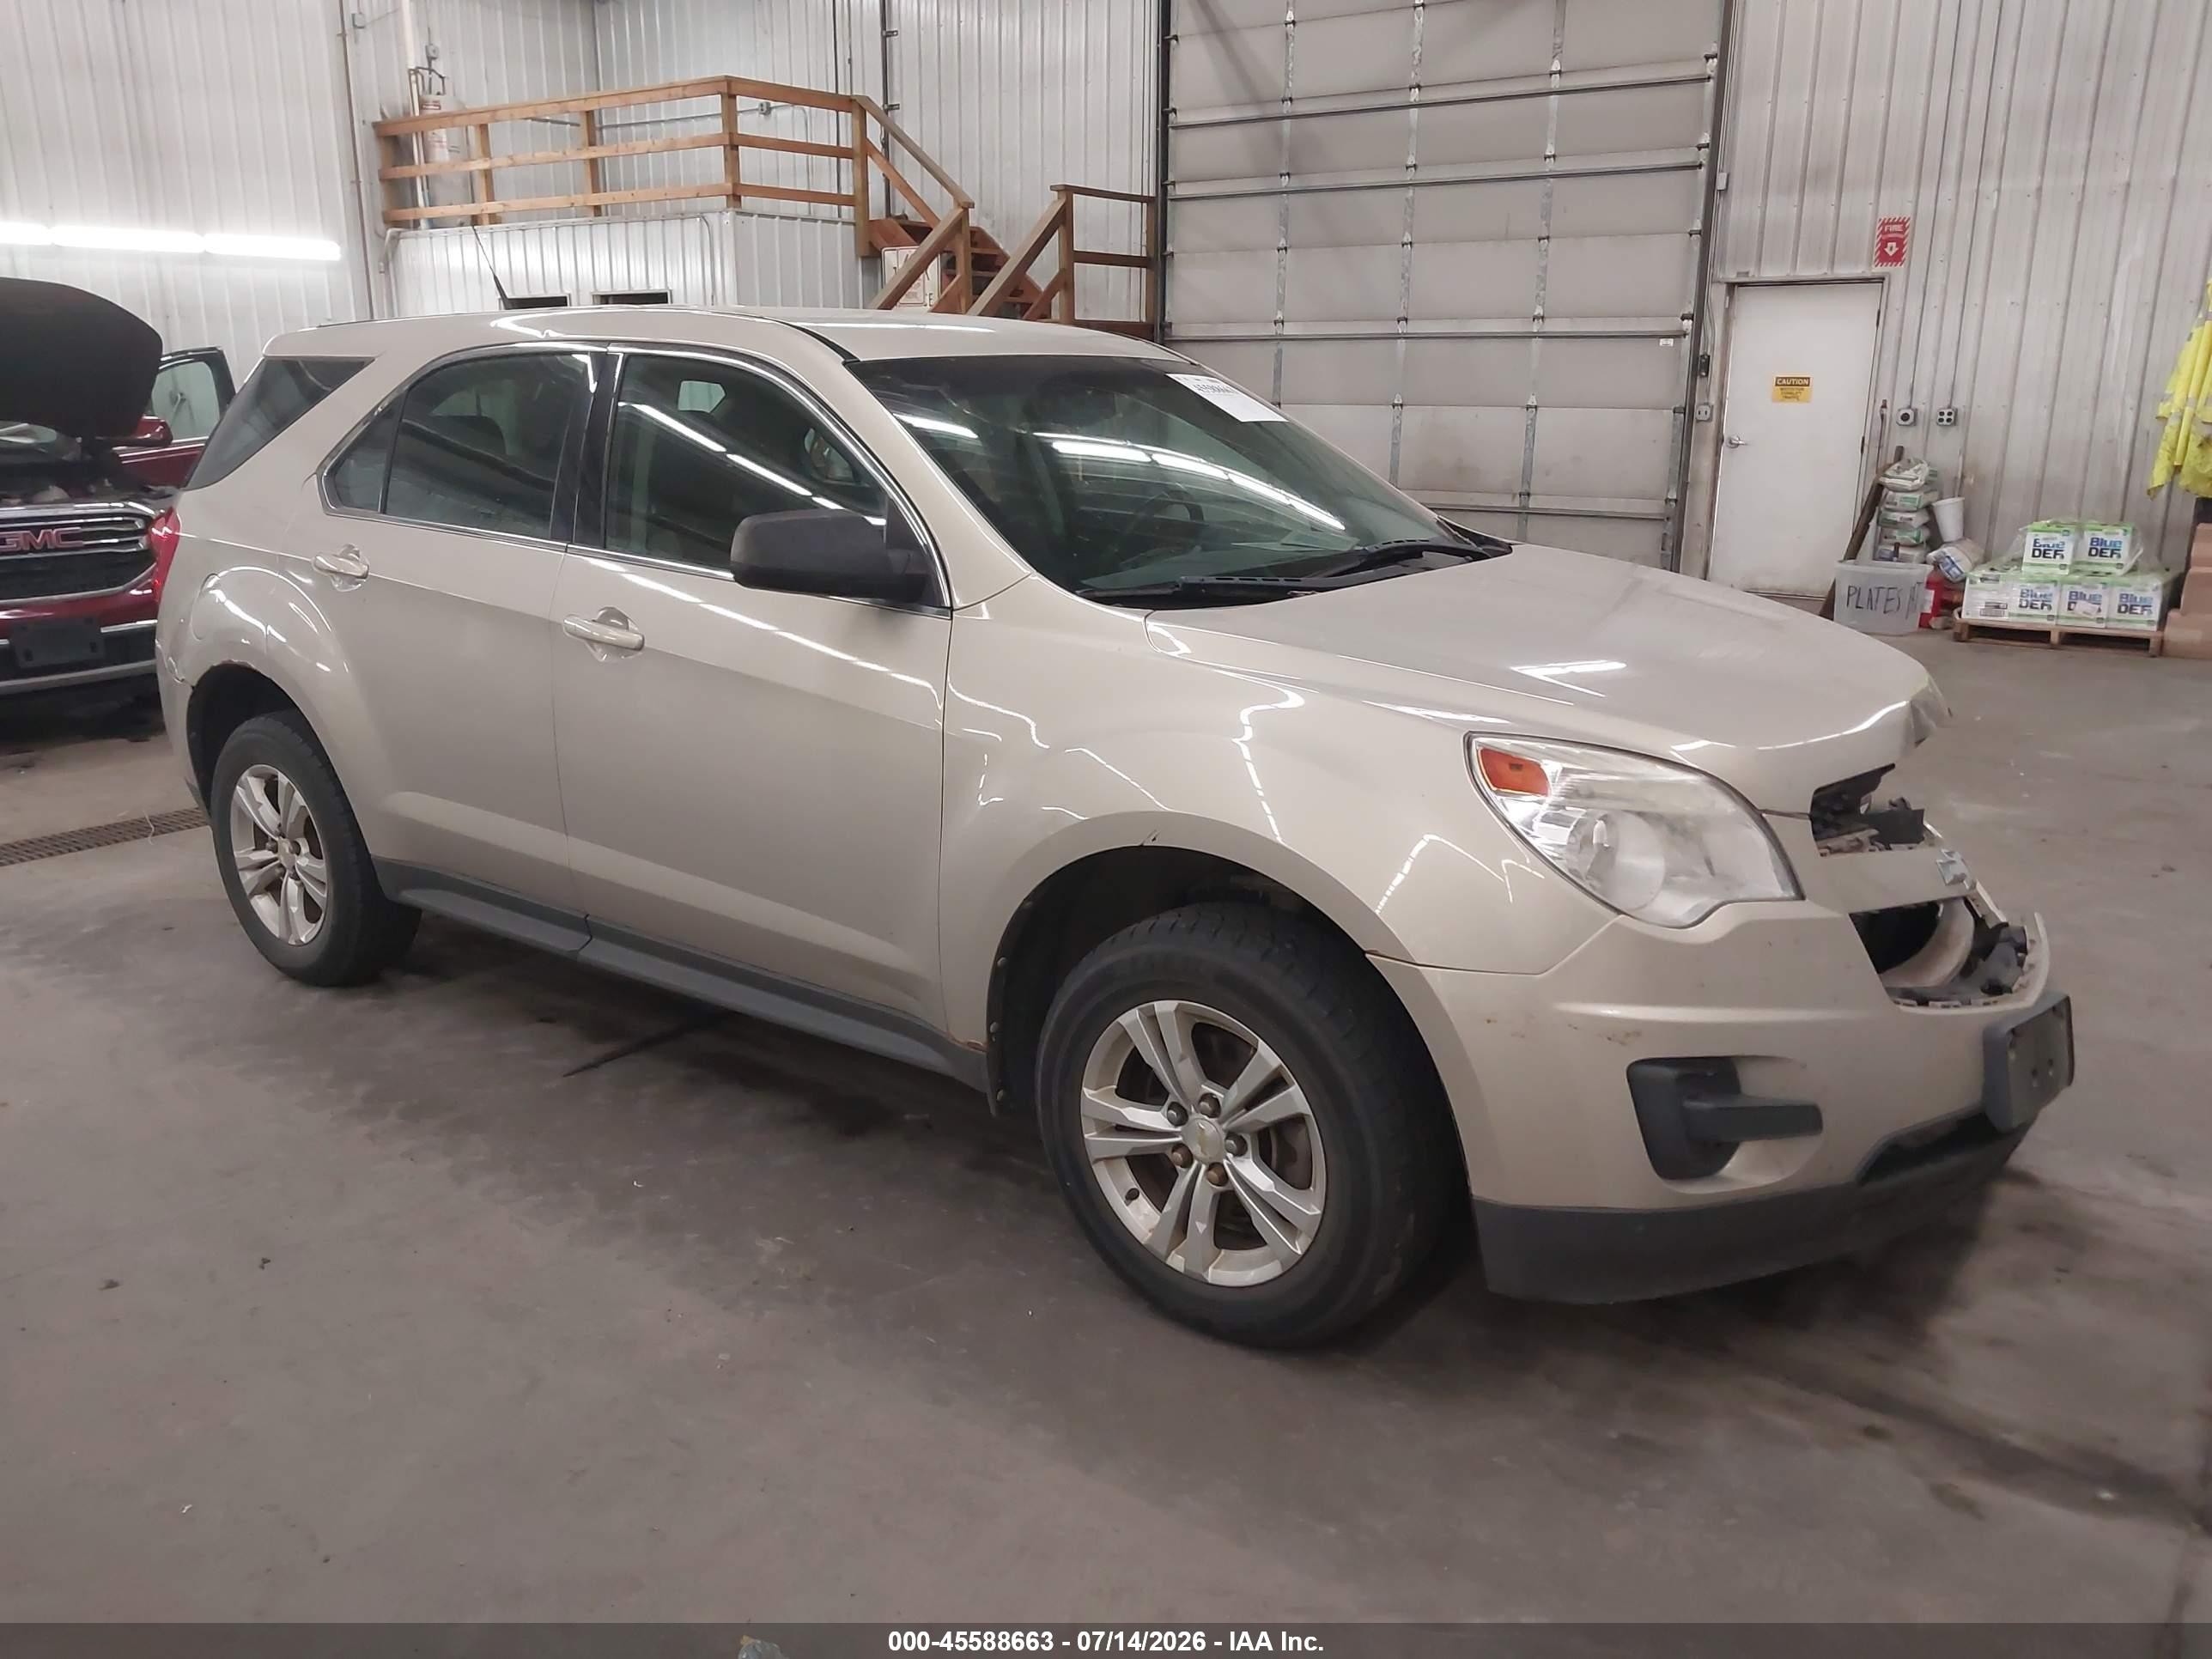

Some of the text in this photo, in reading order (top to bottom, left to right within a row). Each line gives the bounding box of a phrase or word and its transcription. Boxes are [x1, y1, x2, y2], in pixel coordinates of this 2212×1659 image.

[0, 527, 82, 553] GMC
[2089, 537, 2123, 548] Blue
[2031, 548, 2065, 560] DEF
[2087, 547, 2122, 559] DEF
[2020, 588, 2053, 599] Blue
[2069, 590, 2102, 602] Blue
[2119, 592, 2154, 605] Blue
[1846, 585, 1904, 615] PLATES
[2018, 599, 2053, 611] DEF
[2117, 604, 2154, 617] DEF
